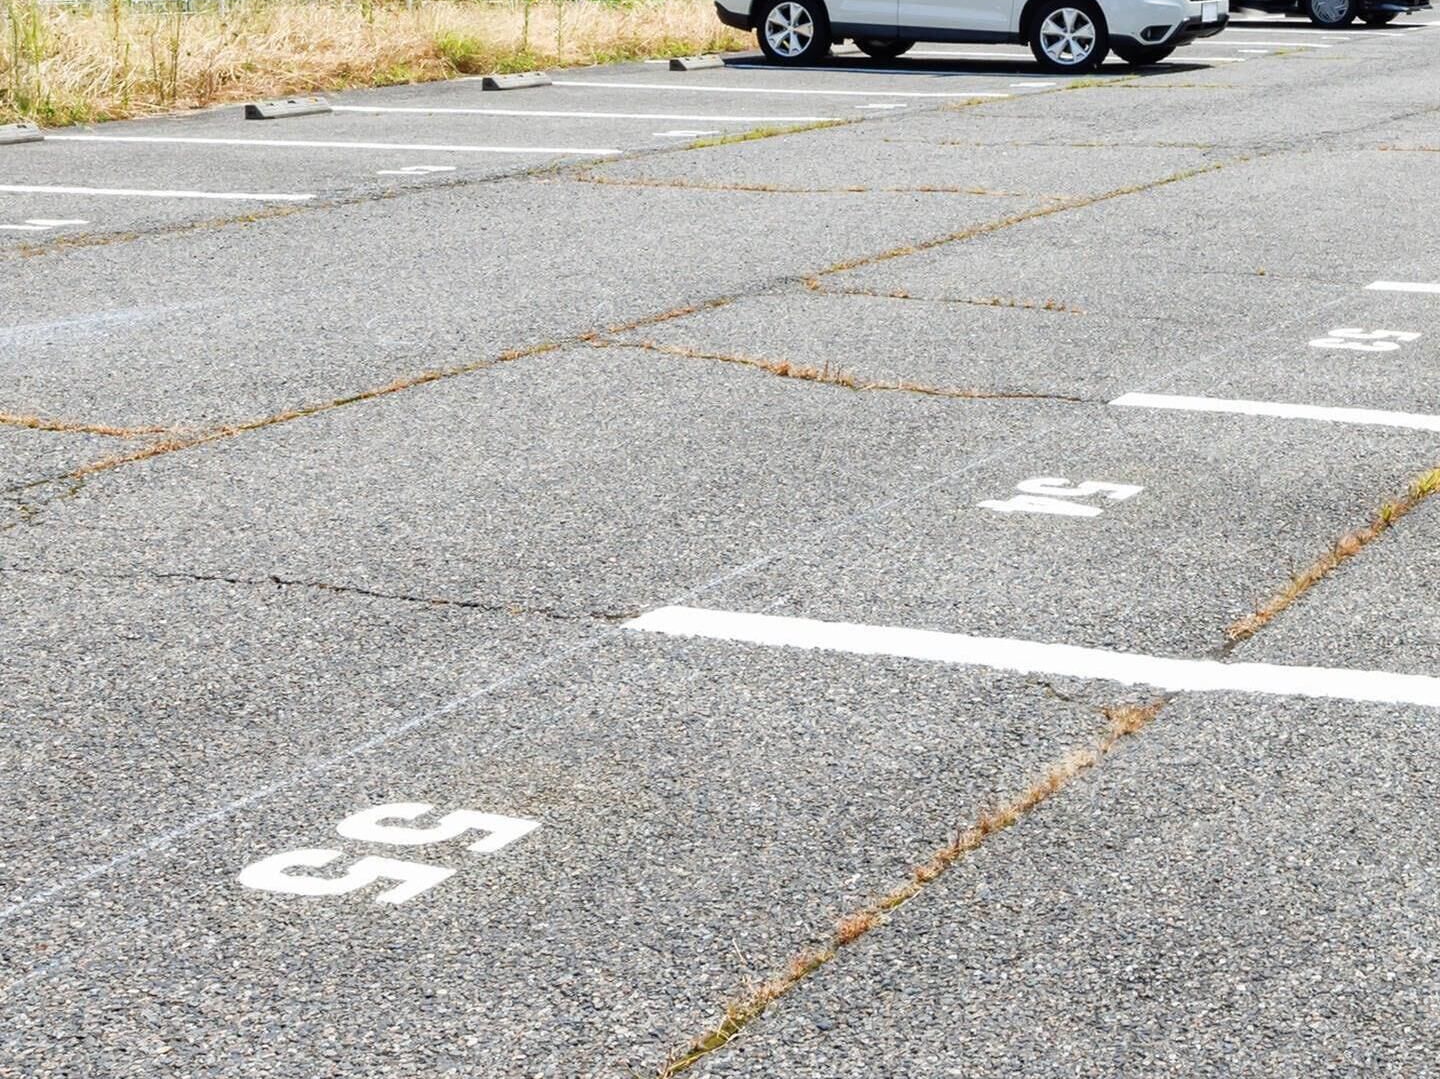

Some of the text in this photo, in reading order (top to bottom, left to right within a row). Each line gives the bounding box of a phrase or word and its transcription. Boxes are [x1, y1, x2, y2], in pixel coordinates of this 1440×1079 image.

[1309, 328, 1421, 351] 53
[978, 477, 1143, 517] 54
[238, 802, 541, 904] 55
